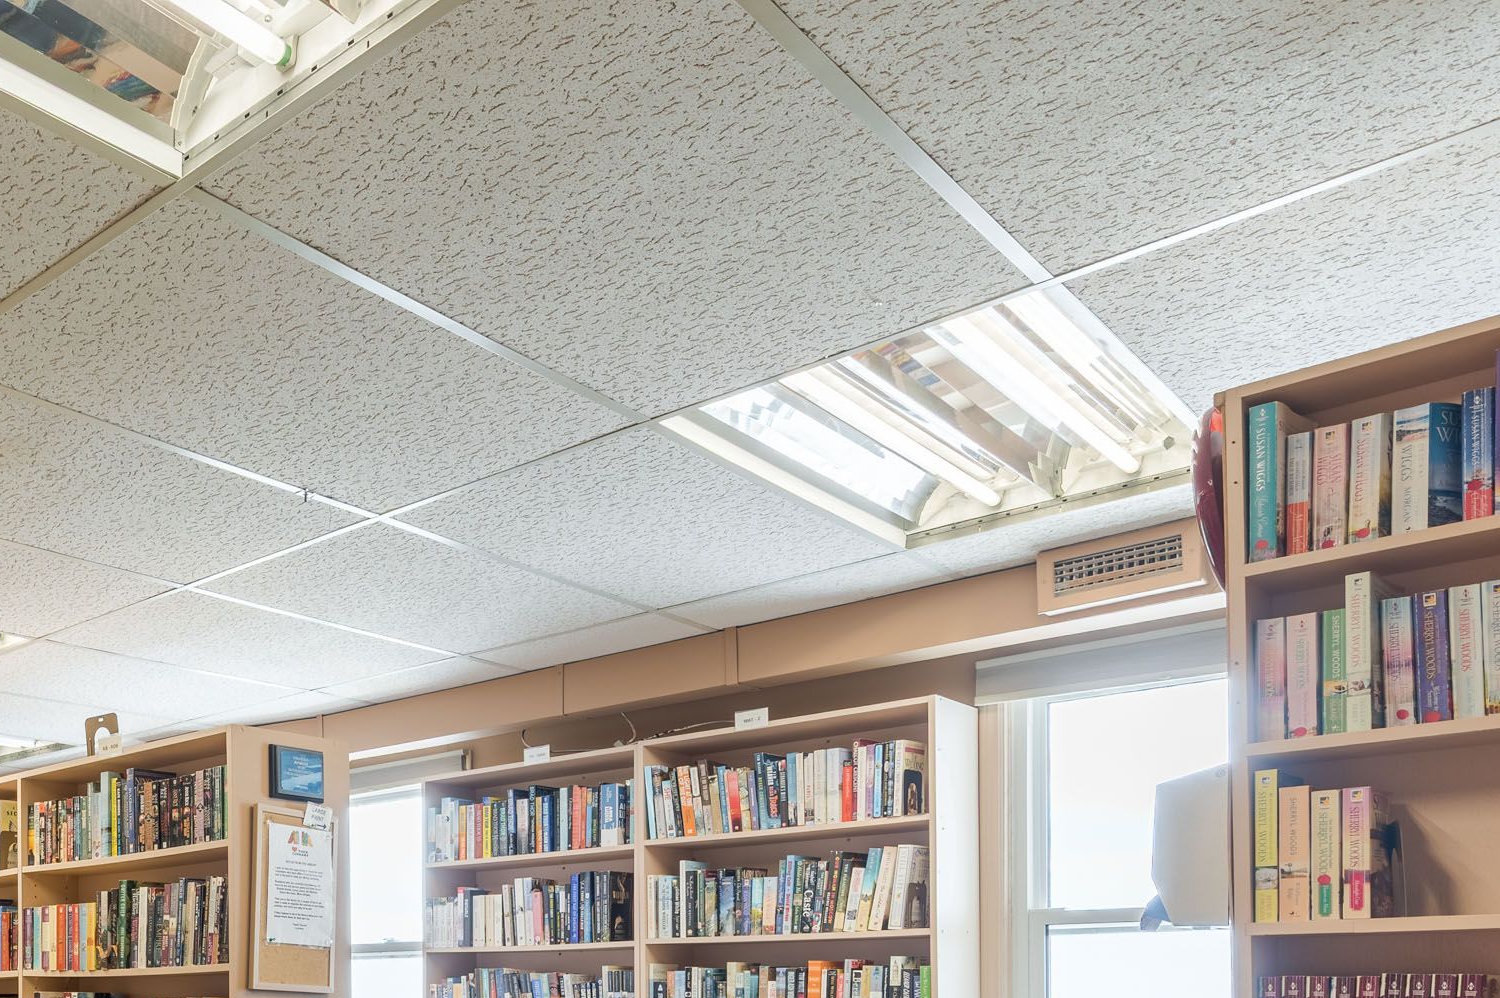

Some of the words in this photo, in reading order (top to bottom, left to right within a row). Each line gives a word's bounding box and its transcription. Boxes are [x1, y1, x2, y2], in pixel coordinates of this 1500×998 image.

[1471, 414, 1480, 438] SUSAN
[1255, 427, 1268, 459] SUSAN
[1471, 440, 1480, 467] WIGGS
[1255, 462, 1267, 492] WIGGS
[1329, 453, 1342, 484] SUSAN
[1400, 444, 1413, 482] WIGGS
[1402, 487, 1412, 523] MORGAN
[1350, 594, 1361, 632] SHERRYL
[1423, 611, 1435, 646] SHERRYL
[1459, 609, 1471, 641] SHERRYL
[1331, 615, 1341, 649] SHERRYL
[1332, 651, 1341, 679] WOODS
[1350, 635, 1361, 667] WOODS
[1425, 648, 1436, 680] WOODS
[1461, 643, 1472, 673] WOODS
[1258, 791, 1266, 829] SHERRYL
[1289, 798, 1297, 827] SHERRYL
[1349, 806, 1359, 837] SHERRYL
[1318, 812, 1328, 848] SHERRYL
[1260, 831, 1268, 863] WOODS
[1318, 850, 1328, 875] WOOD
[1350, 840, 1359, 868] WOODS
[802, 889, 814, 918] Caste
